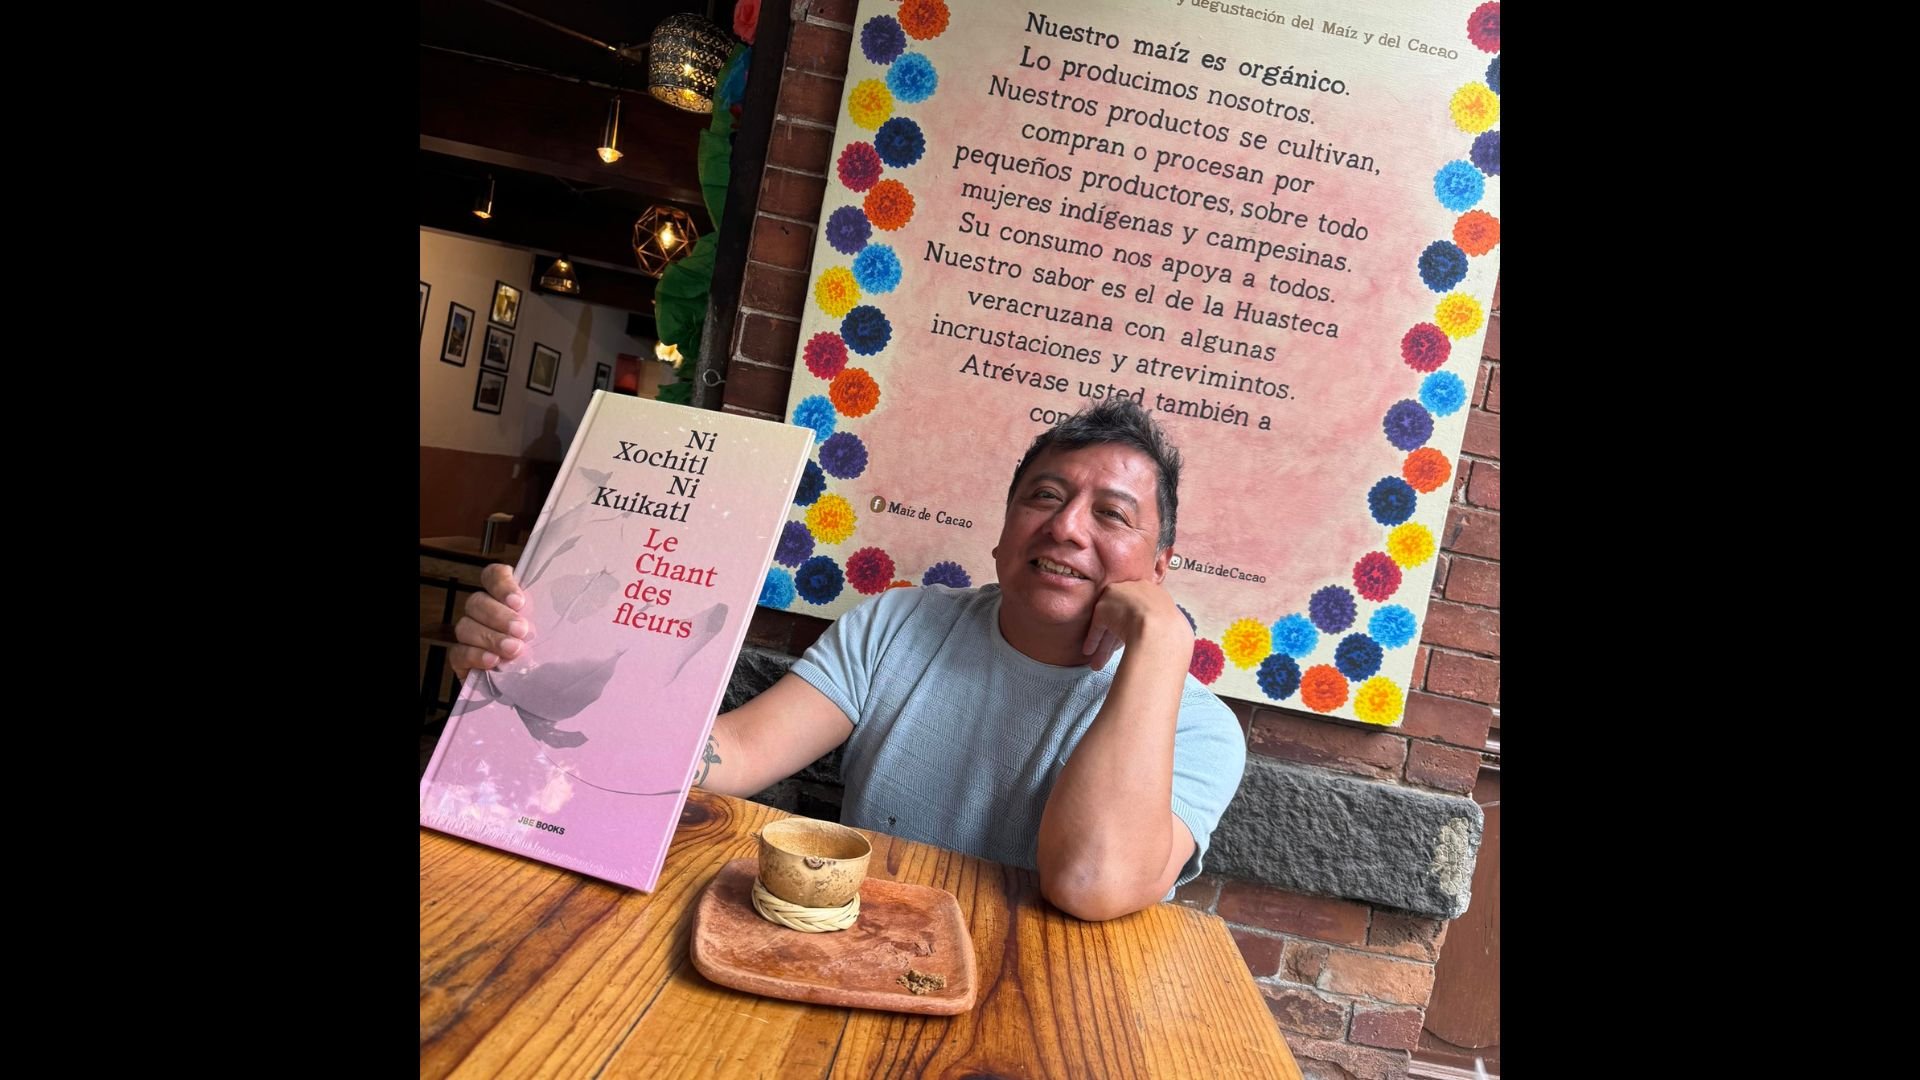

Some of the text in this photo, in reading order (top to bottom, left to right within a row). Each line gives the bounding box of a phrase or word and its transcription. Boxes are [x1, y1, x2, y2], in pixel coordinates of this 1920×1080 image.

[1024, 11, 1350, 97] Nuestro maíz es orgánico.
[1290, 14, 1315, 31] del
[1321, 20, 1358, 40] Maíz
[1363, 32, 1375, 45] y
[1378, 32, 1401, 49] del
[1407, 38, 1459, 60] Cacao
[1018, 44, 1315, 125] Lo producimos nosotros.
[987, 74, 1381, 177] Nuestros productos se cultivan,
[1021, 123, 1316, 197] compran o procesan por
[951, 144, 1369, 241] pequeños productores, sobre todo
[960, 182, 1352, 273] mujeres indígenas y campesinas.
[958, 211, 1335, 304] Su consumo nos apoya a todos.
[923, 239, 1339, 339] Nuestro sabor es el de la Huasteca
[967, 290, 1277, 362] veracruzana con algunas
[930, 312, 1295, 401] incrustaciones y atrevimintos.
[958, 353, 1272, 431] Atrévase usted también a
[612, 440, 709, 475] Xochitl
[684, 429, 718, 452] Ni
[591, 486, 690, 522] Kuikatl
[666, 475, 700, 498] Ni
[643, 527, 679, 552] Le
[918, 507, 931, 520] de
[936, 511, 973, 528] Cacao
[624, 579, 672, 606] des
[635, 552, 718, 587] Chant
[612, 602, 693, 638] fleurs
[535, 820, 566, 835] BOOKS
